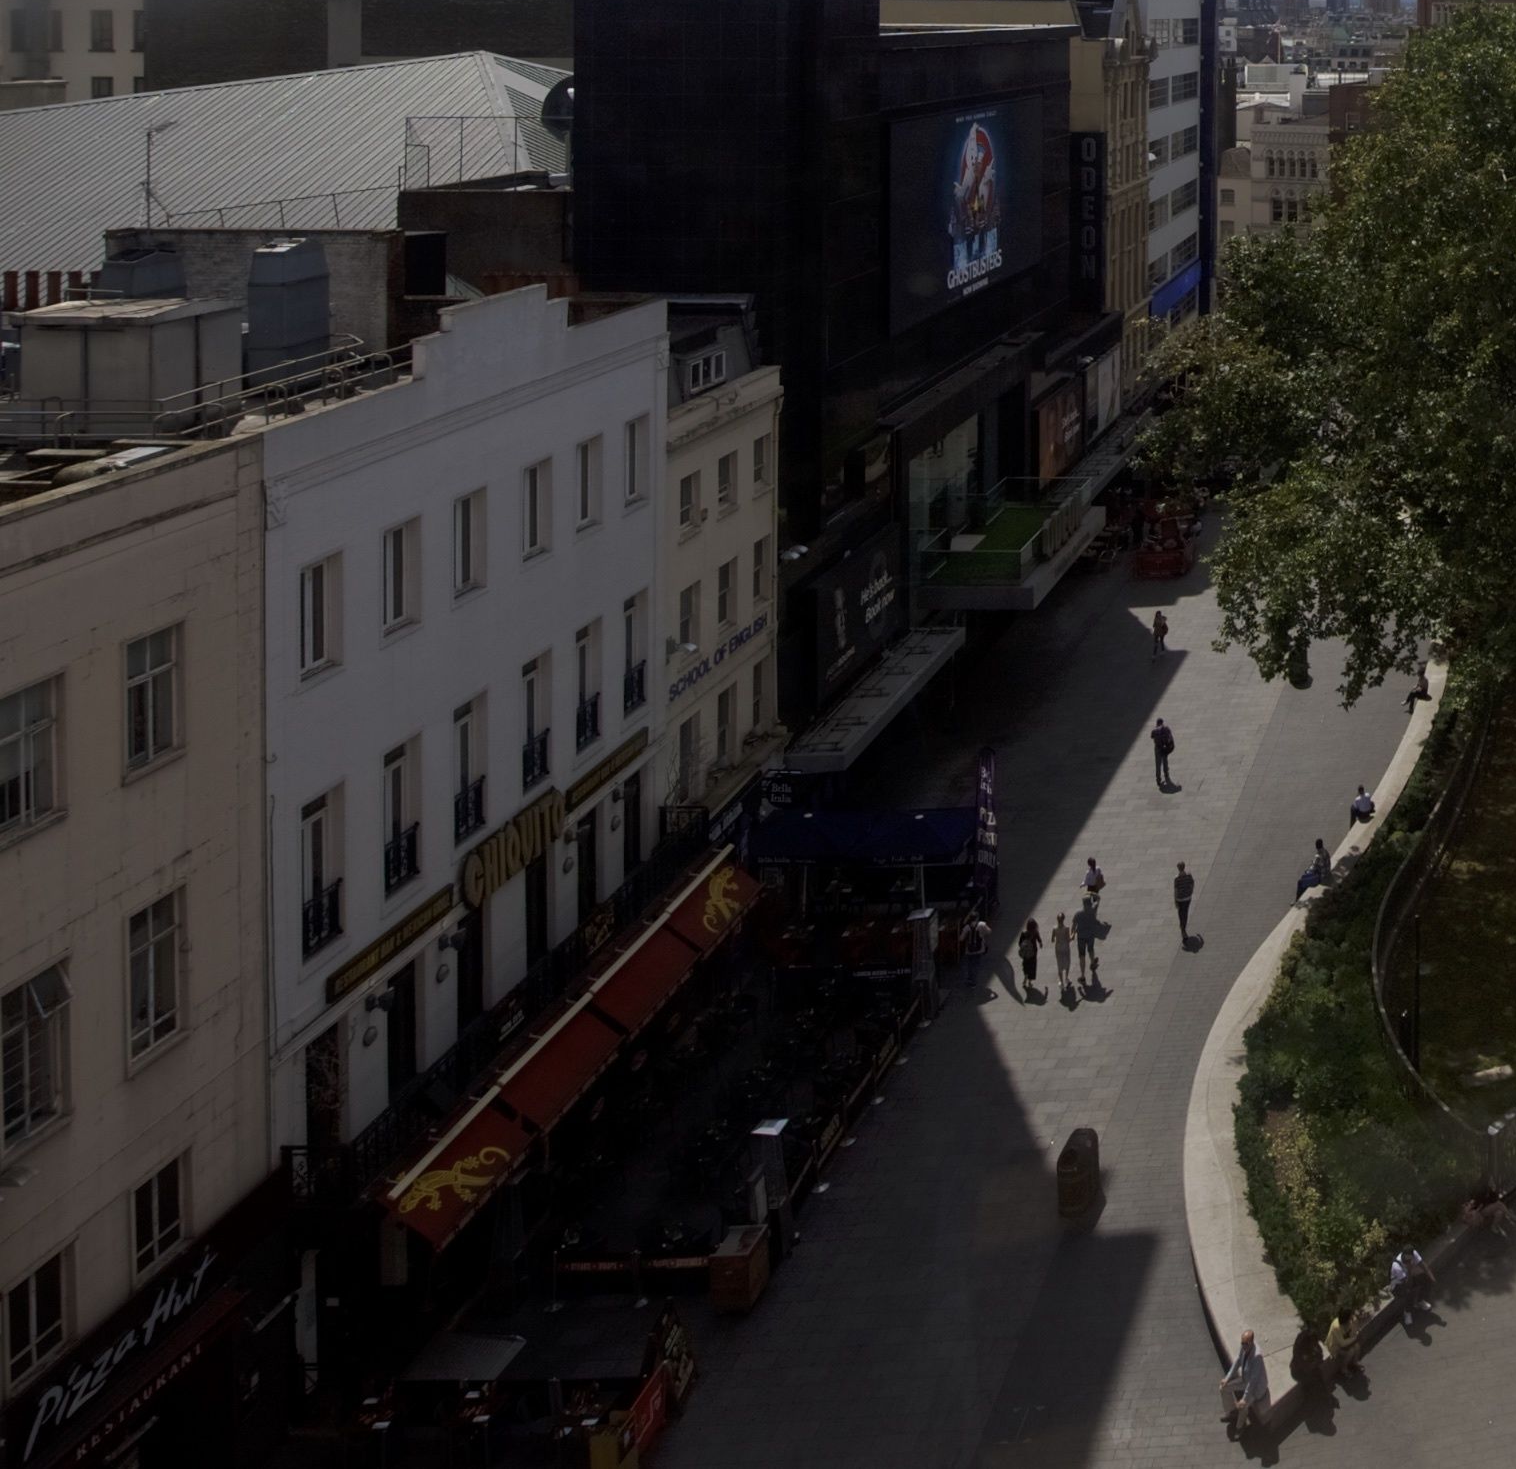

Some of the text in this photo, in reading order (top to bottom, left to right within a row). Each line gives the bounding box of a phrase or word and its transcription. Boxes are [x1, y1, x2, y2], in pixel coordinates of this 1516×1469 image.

[946, 248, 1003, 290] GHOSTBUSTERS
[1080, 136, 1097, 280] ODEON
[669, 611, 768, 702] SCHOOL OF ENGLISH
[463, 787, 566, 910] CHIQUITO
[24, 1244, 219, 1462] Pizza Hut
